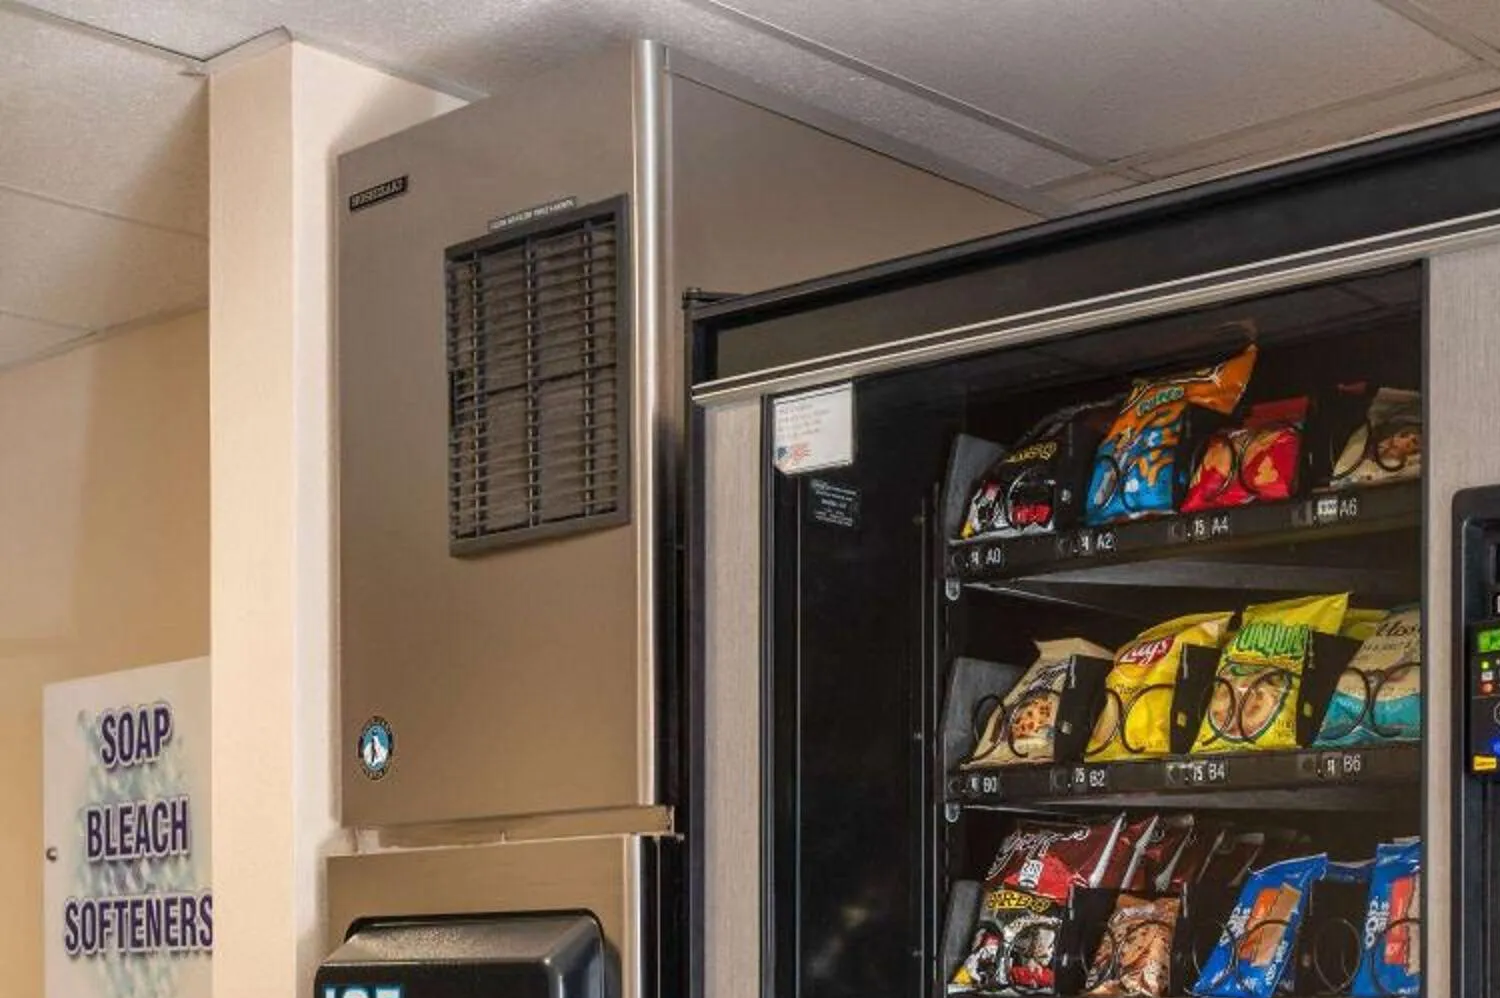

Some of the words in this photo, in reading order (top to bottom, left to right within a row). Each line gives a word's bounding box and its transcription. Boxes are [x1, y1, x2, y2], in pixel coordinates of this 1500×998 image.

[101, 706, 170, 765] SOAP
[86, 800, 188, 858] BLEACH
[64, 894, 213, 952] SOFTENERS
